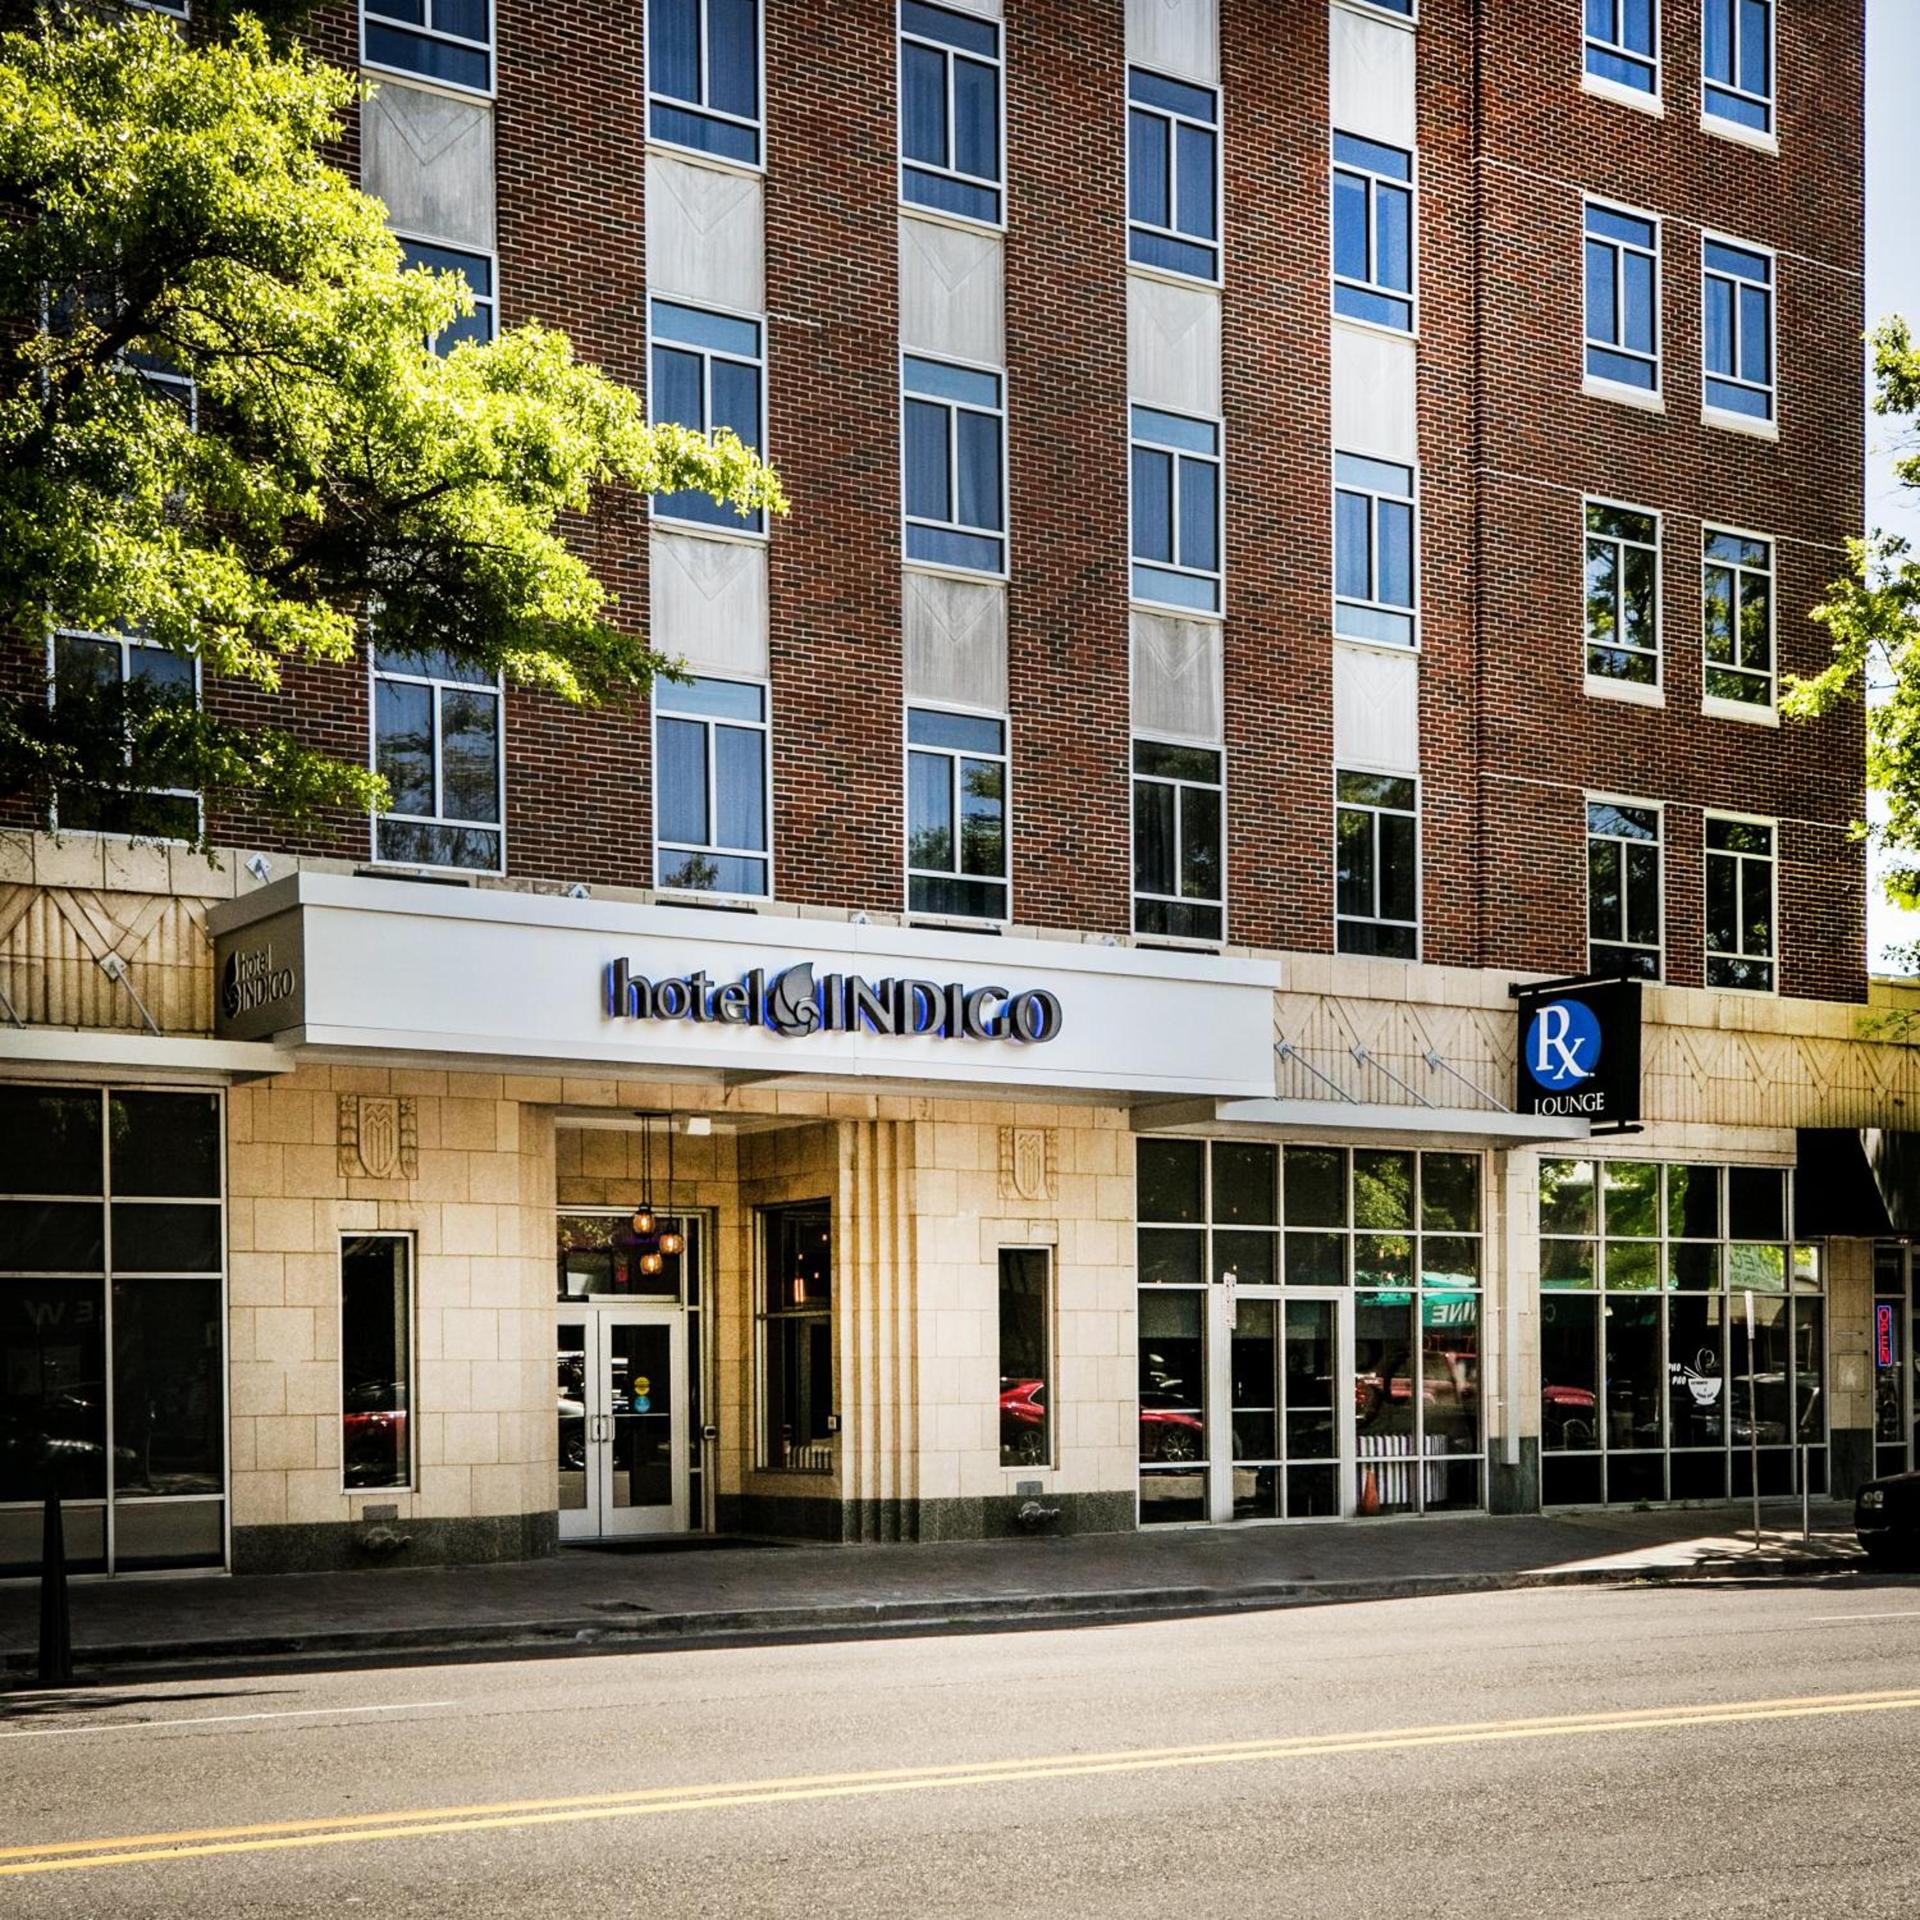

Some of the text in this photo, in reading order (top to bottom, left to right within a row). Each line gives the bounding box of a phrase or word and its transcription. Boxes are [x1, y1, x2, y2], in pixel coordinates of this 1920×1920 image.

[241, 944, 271, 980] hotel
[241, 968, 295, 1011] INDIGO
[608, 957, 1062, 1043] hotel INDIGO
[1534, 1092, 1605, 1116] LOUNGE
[1879, 1307, 1890, 1364] OPEN
